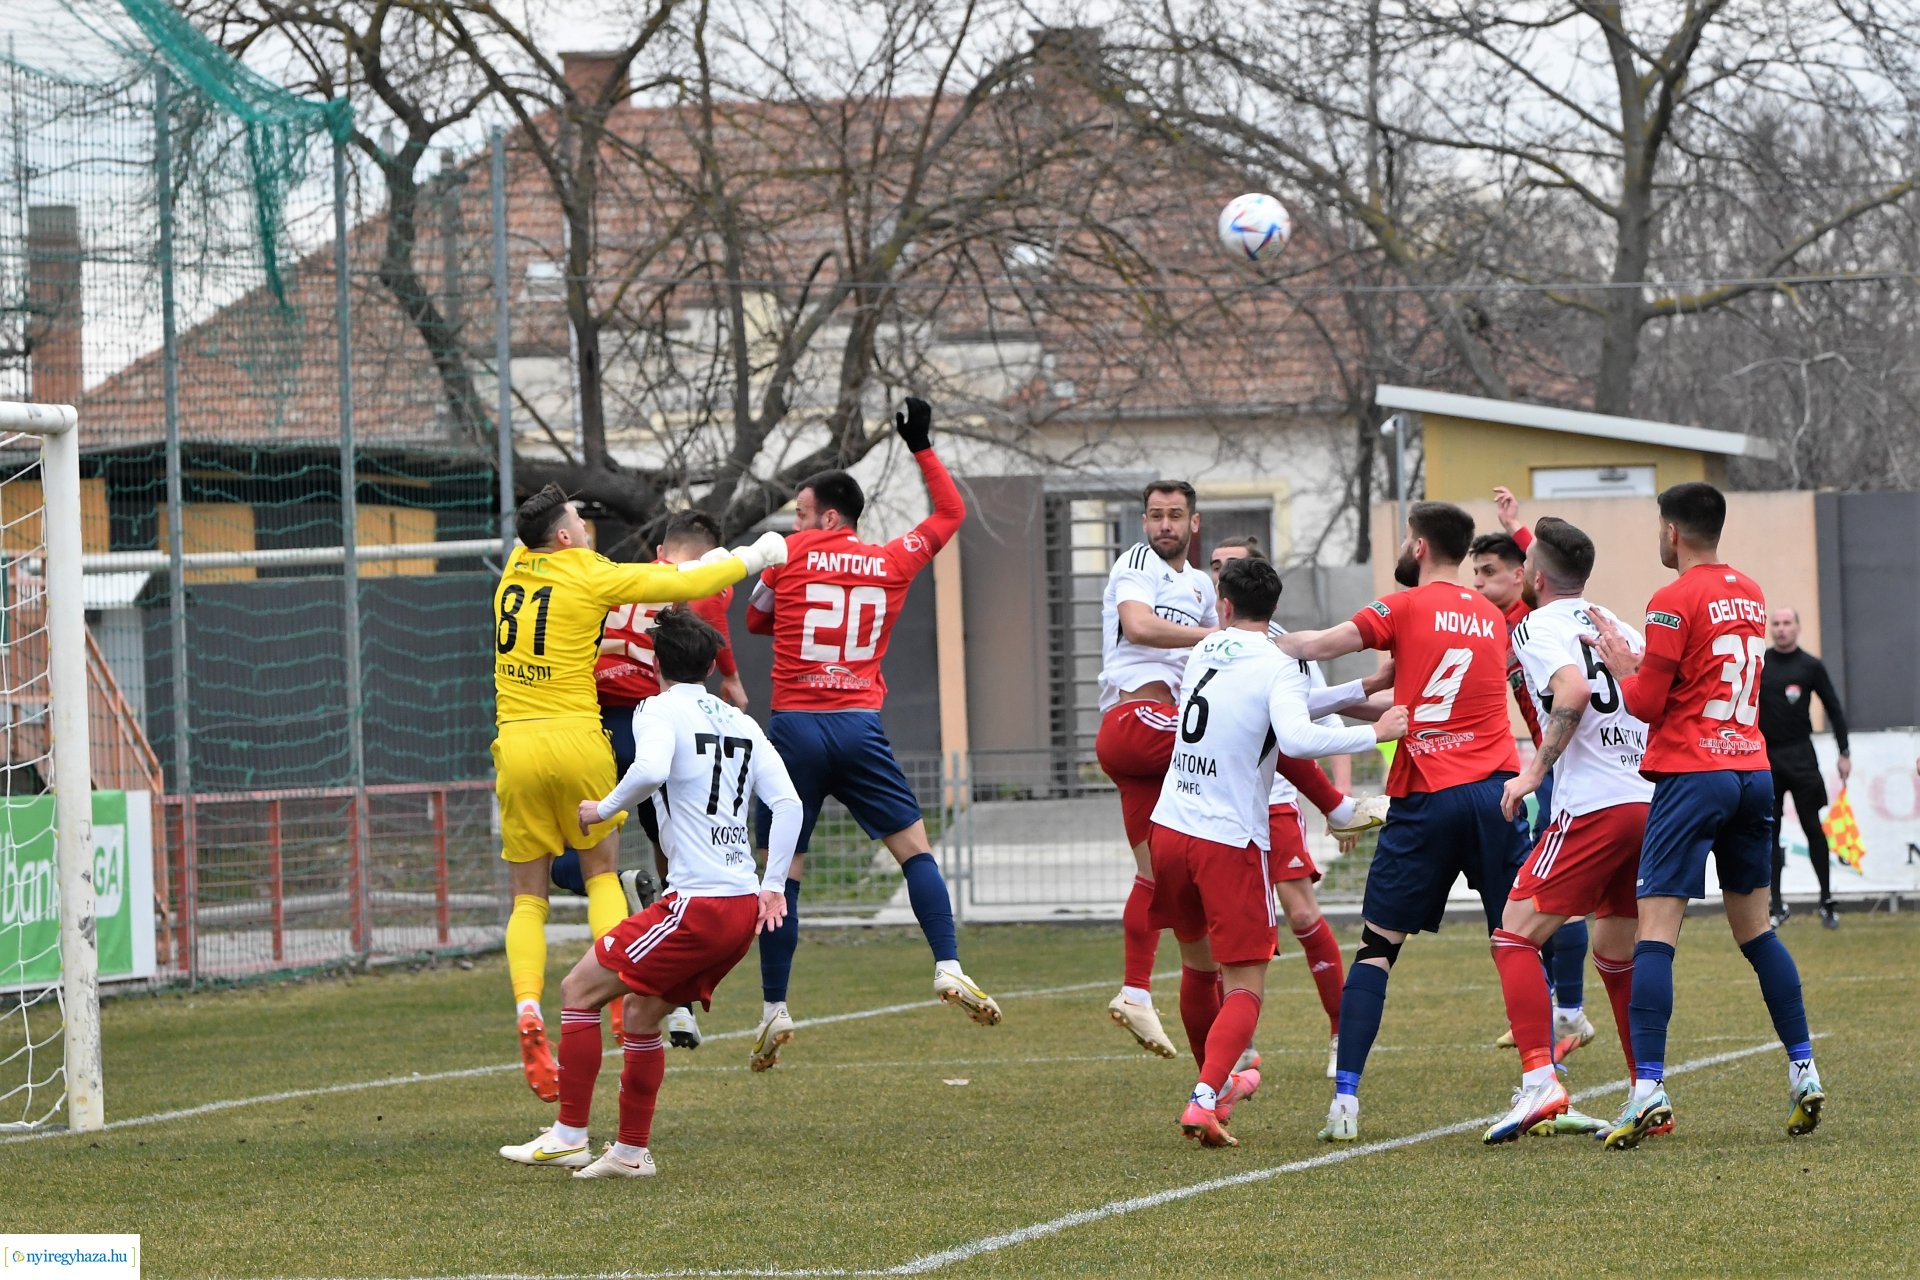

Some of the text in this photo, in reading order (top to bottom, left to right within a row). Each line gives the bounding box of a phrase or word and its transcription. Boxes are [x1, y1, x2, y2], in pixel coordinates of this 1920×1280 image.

[806, 551, 887, 577] PANTOVIC
[497, 584, 553, 656] 81
[800, 583, 887, 662] 20
[1434, 611, 1495, 640] NOVÁK
[1707, 598, 1765, 625] DEUTSCH
[1181, 667, 1219, 744] 6
[1413, 647, 1474, 722] 9
[1702, 634, 1767, 727] 30
[694, 732, 753, 817] 77
